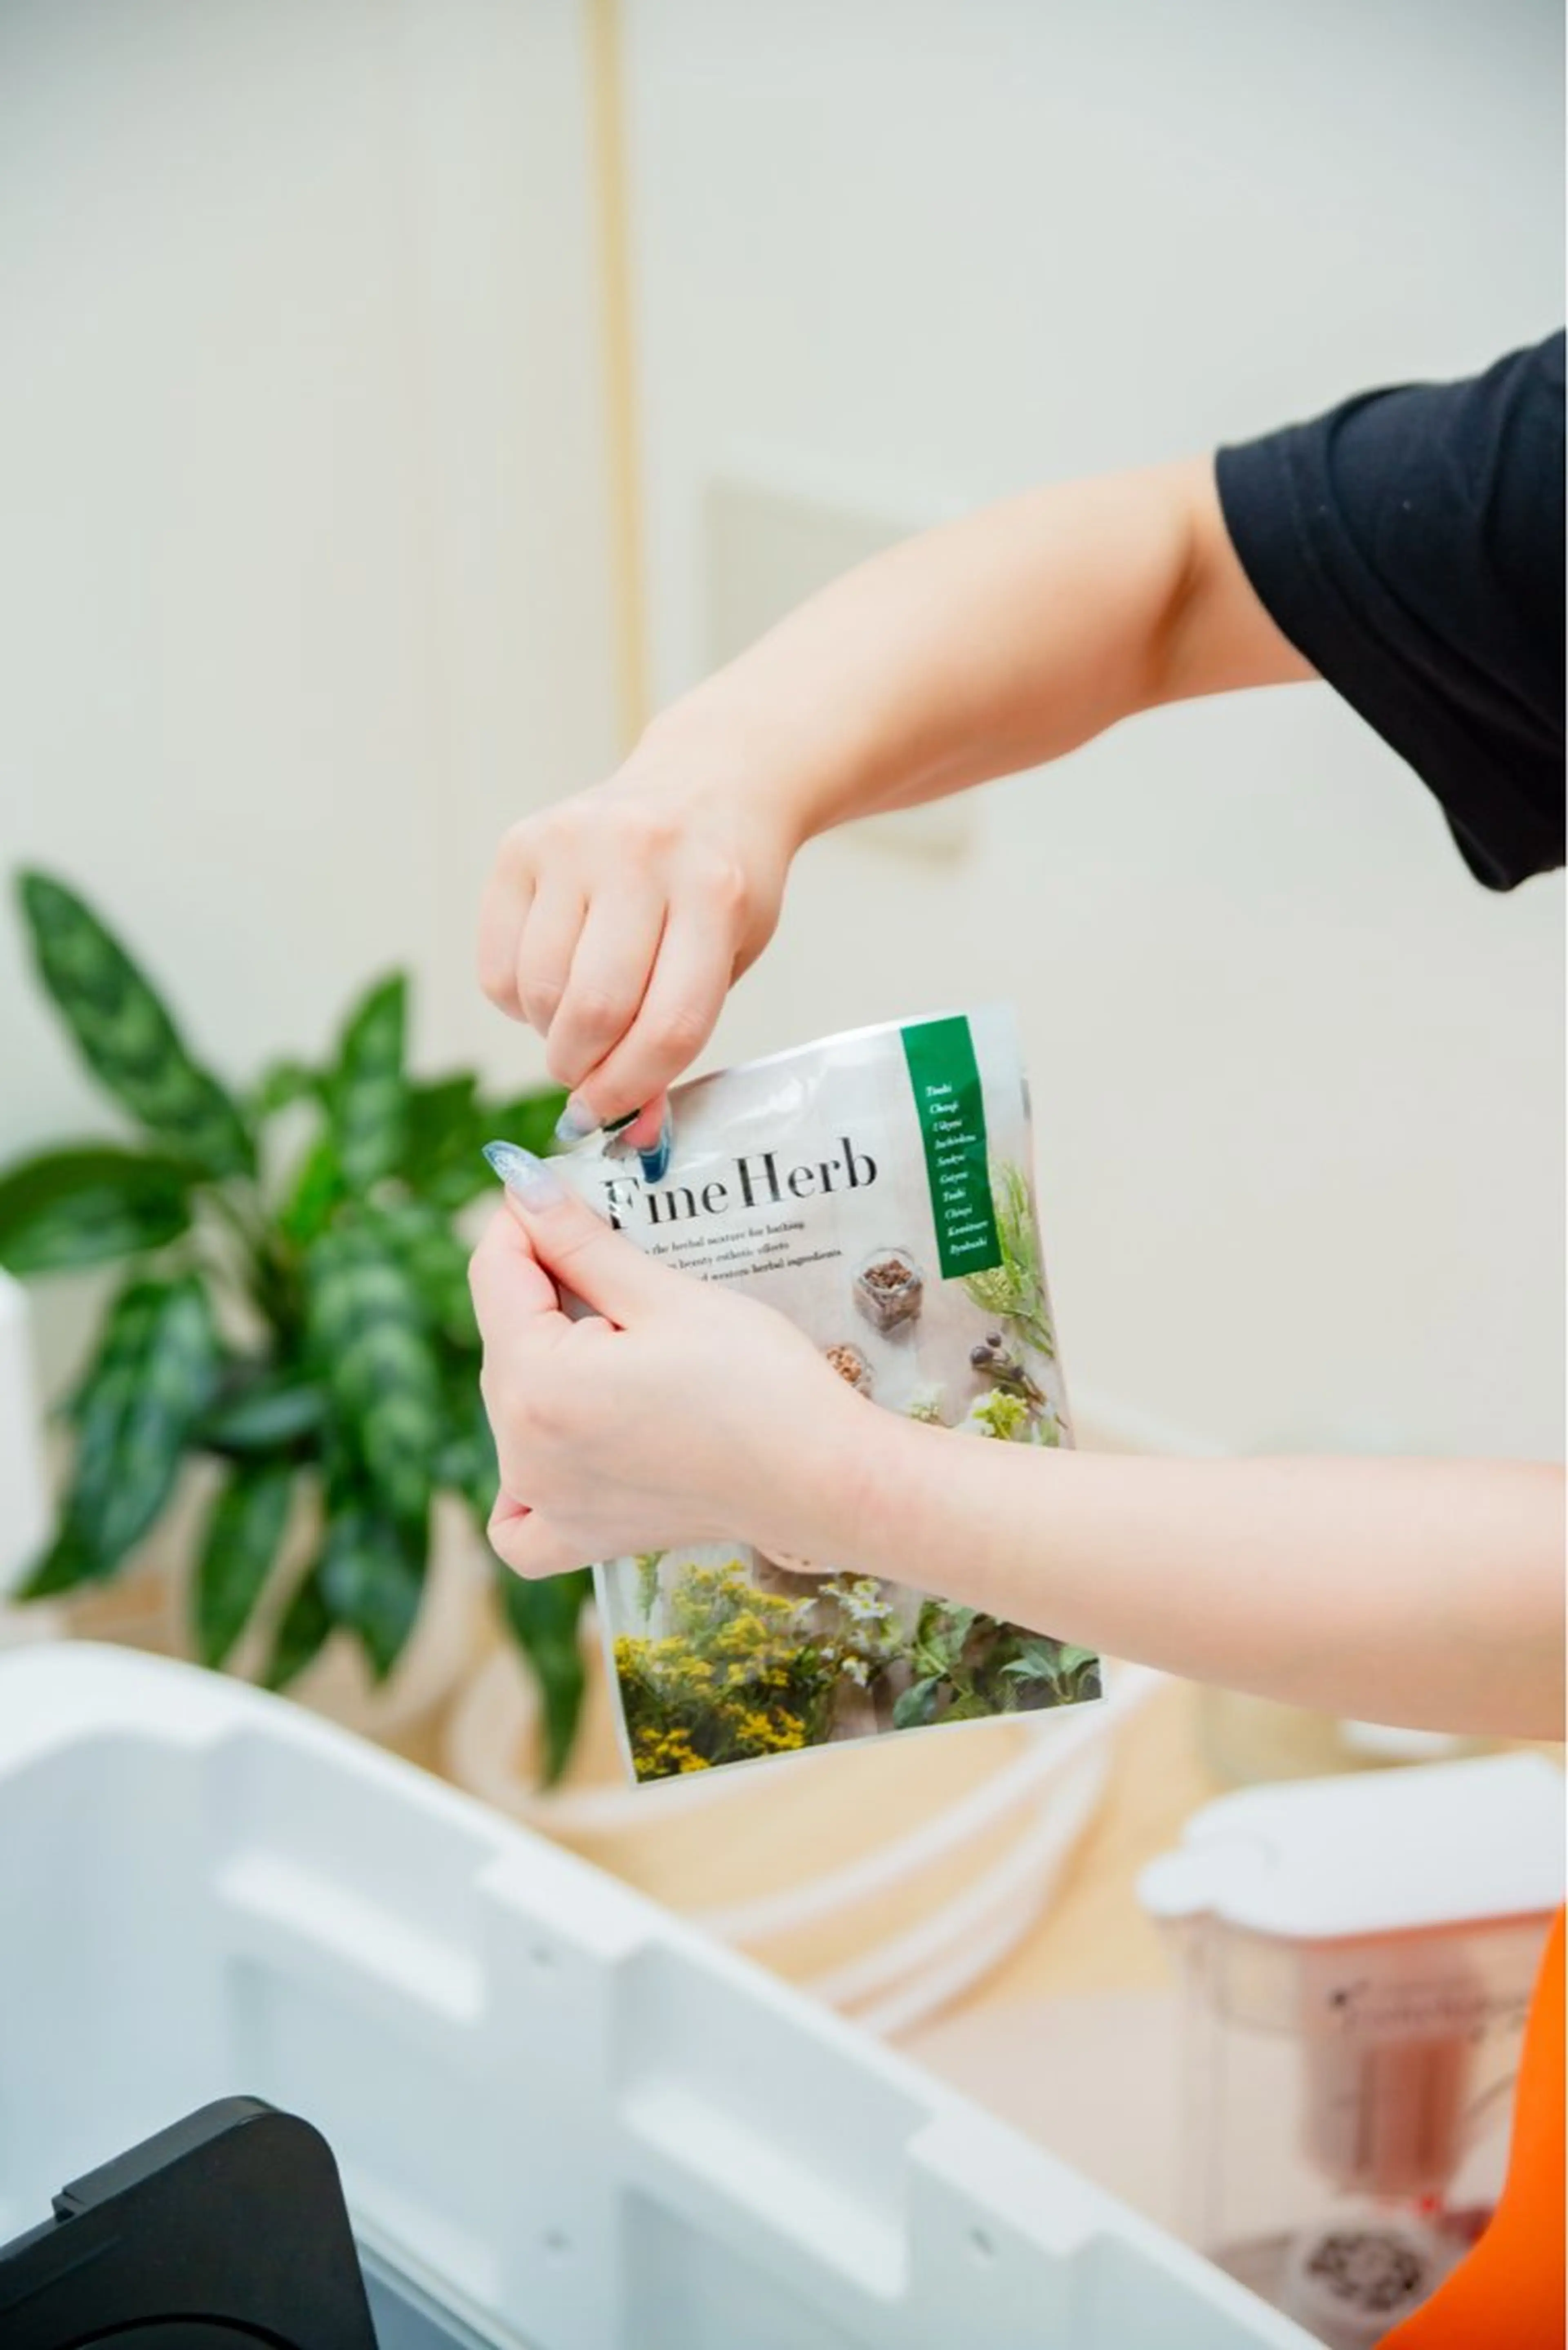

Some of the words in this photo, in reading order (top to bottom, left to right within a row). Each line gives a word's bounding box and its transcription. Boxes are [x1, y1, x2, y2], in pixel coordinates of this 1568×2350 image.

[599, 1176, 728, 1230] Fine
[732, 1137, 878, 1207] Herb
[672, 1236, 705, 1252] herbal
[751, 1257, 785, 1274] herbal
